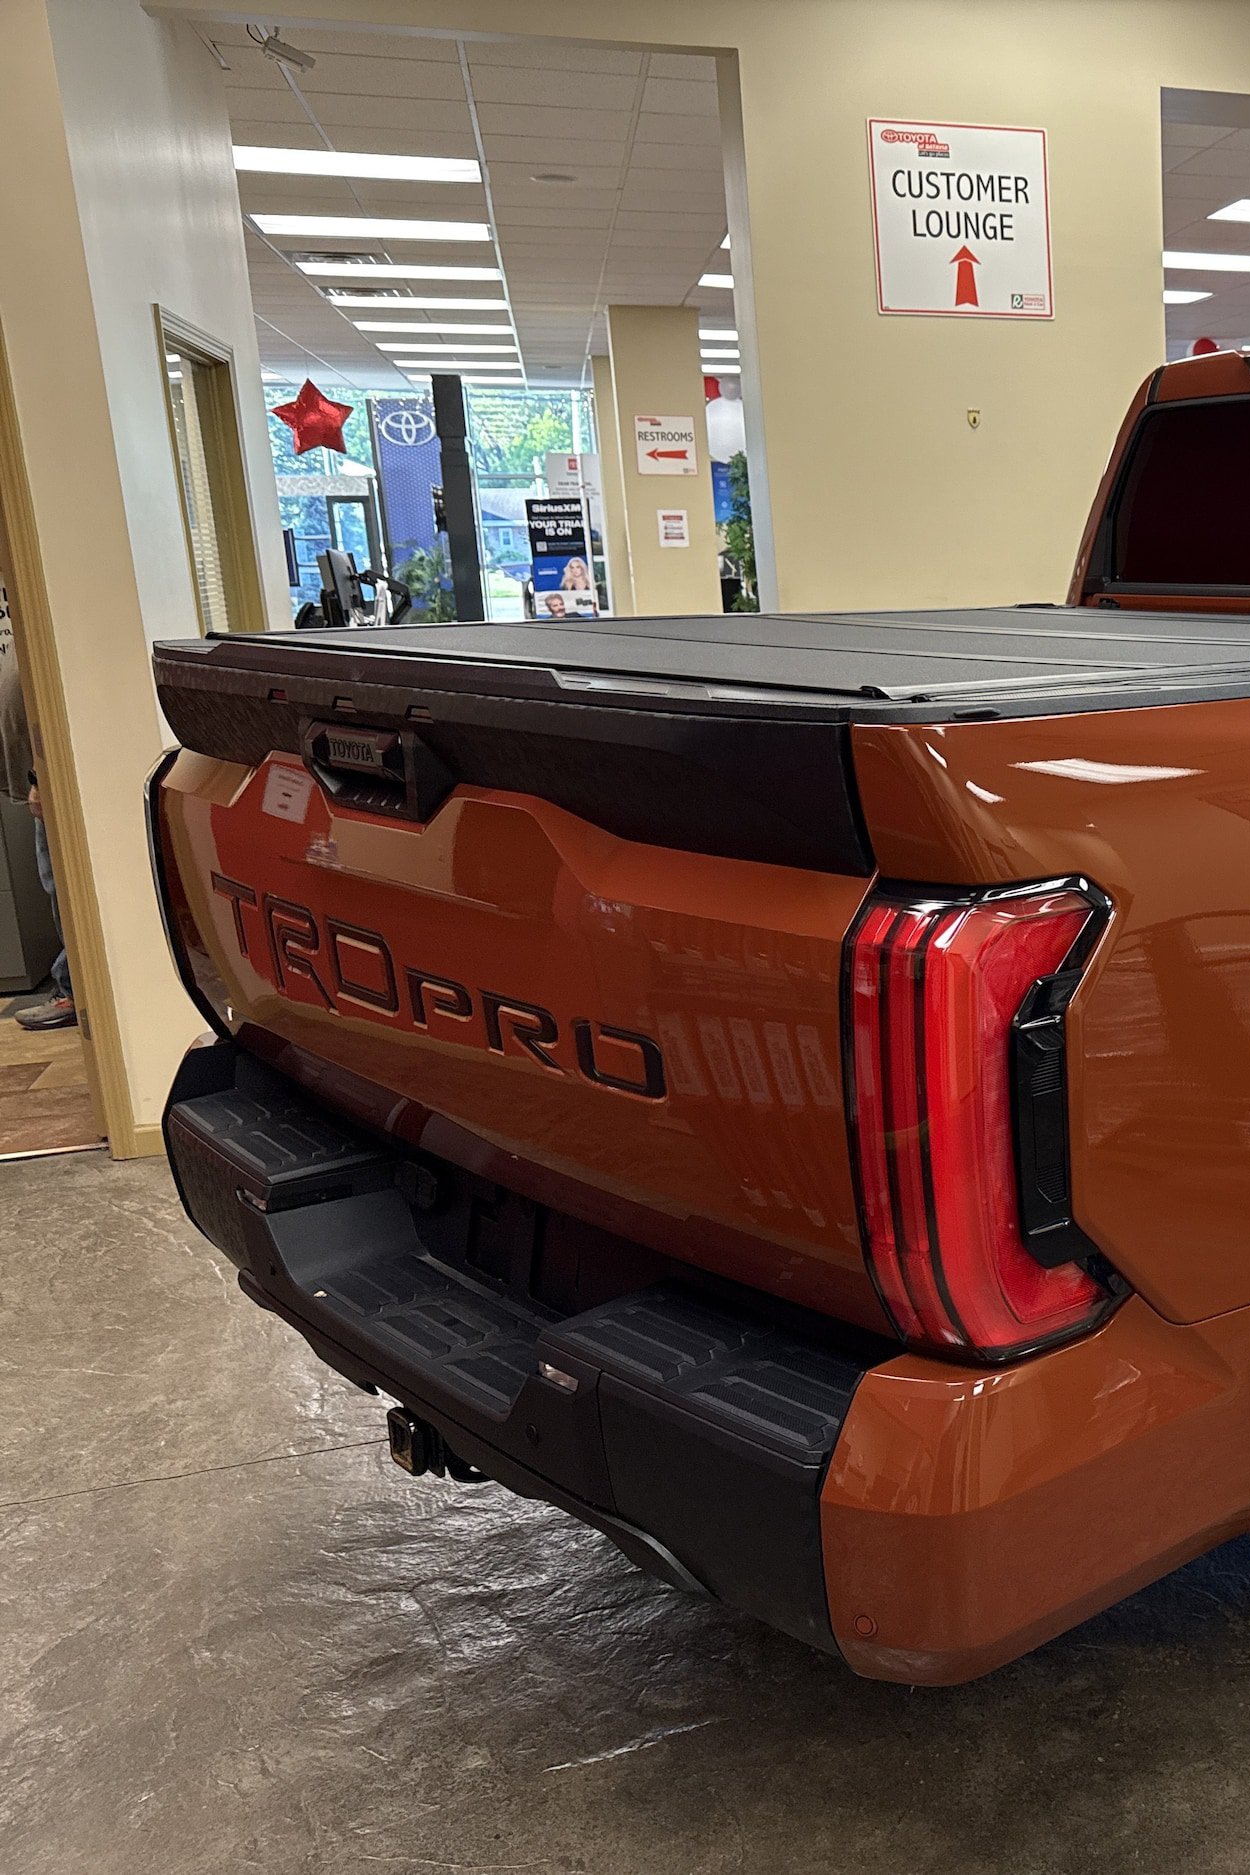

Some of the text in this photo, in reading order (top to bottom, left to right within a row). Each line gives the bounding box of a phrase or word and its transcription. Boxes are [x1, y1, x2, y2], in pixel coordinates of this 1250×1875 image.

[898, 132, 937, 145] TOYOTA
[891, 169, 1030, 204] CUSTOMER
[912, 209, 1014, 241] LOUNGE
[637, 431, 694, 442] RESTROOMS
[531, 503, 581, 513] SiriusXM
[529, 519, 583, 529] YOUR TRIA
[545, 528, 573, 537] IS ON
[330, 739, 375, 762] TOYOTA
[210, 870, 668, 1103] TRD PRO
